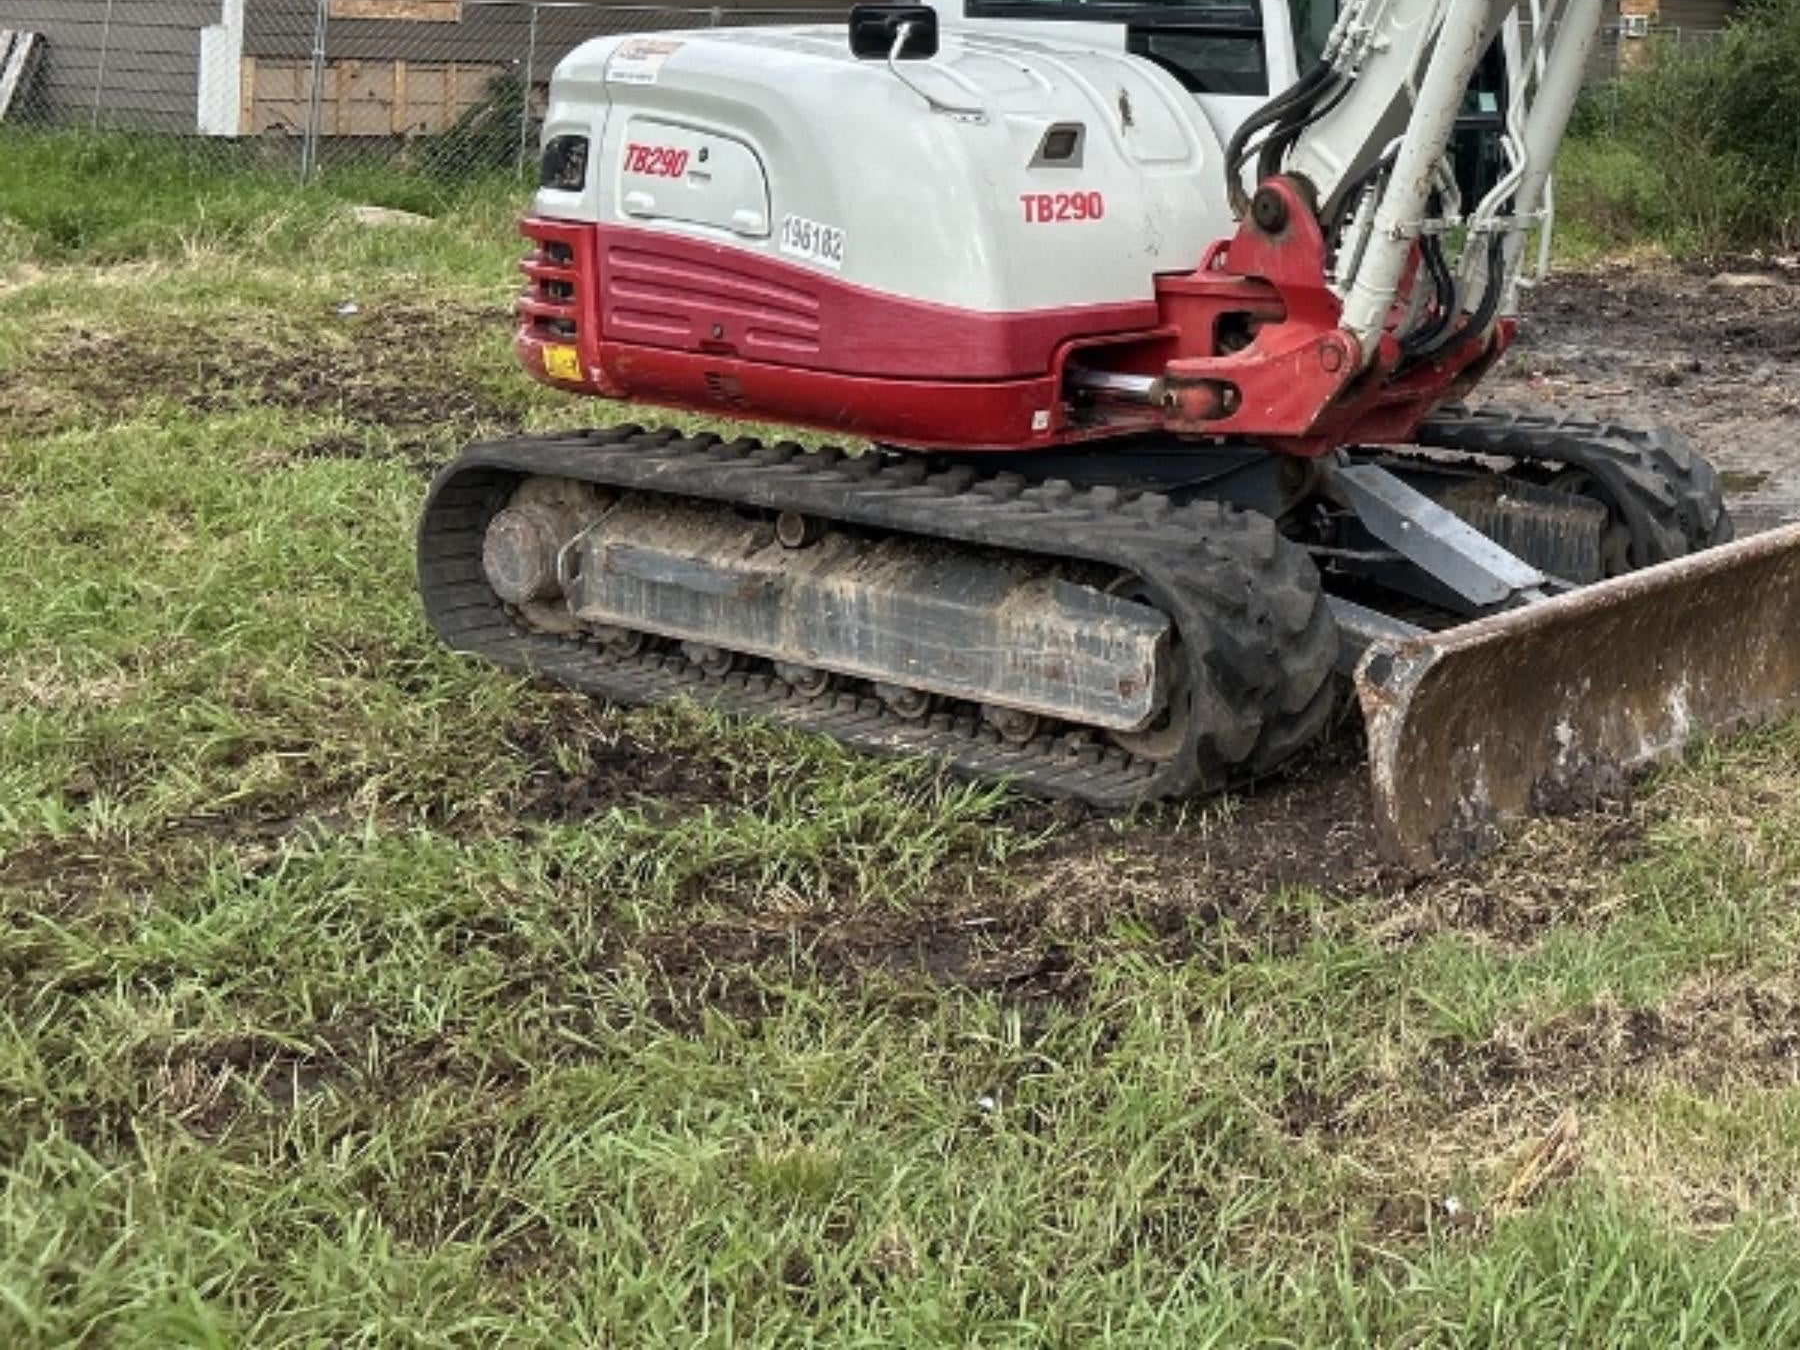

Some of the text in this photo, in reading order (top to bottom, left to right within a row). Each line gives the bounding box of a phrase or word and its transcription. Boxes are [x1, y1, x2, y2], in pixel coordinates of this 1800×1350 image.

[623, 143, 690, 178] TB290
[1019, 191, 1104, 223] TB290
[784, 218, 841, 261] 196182
